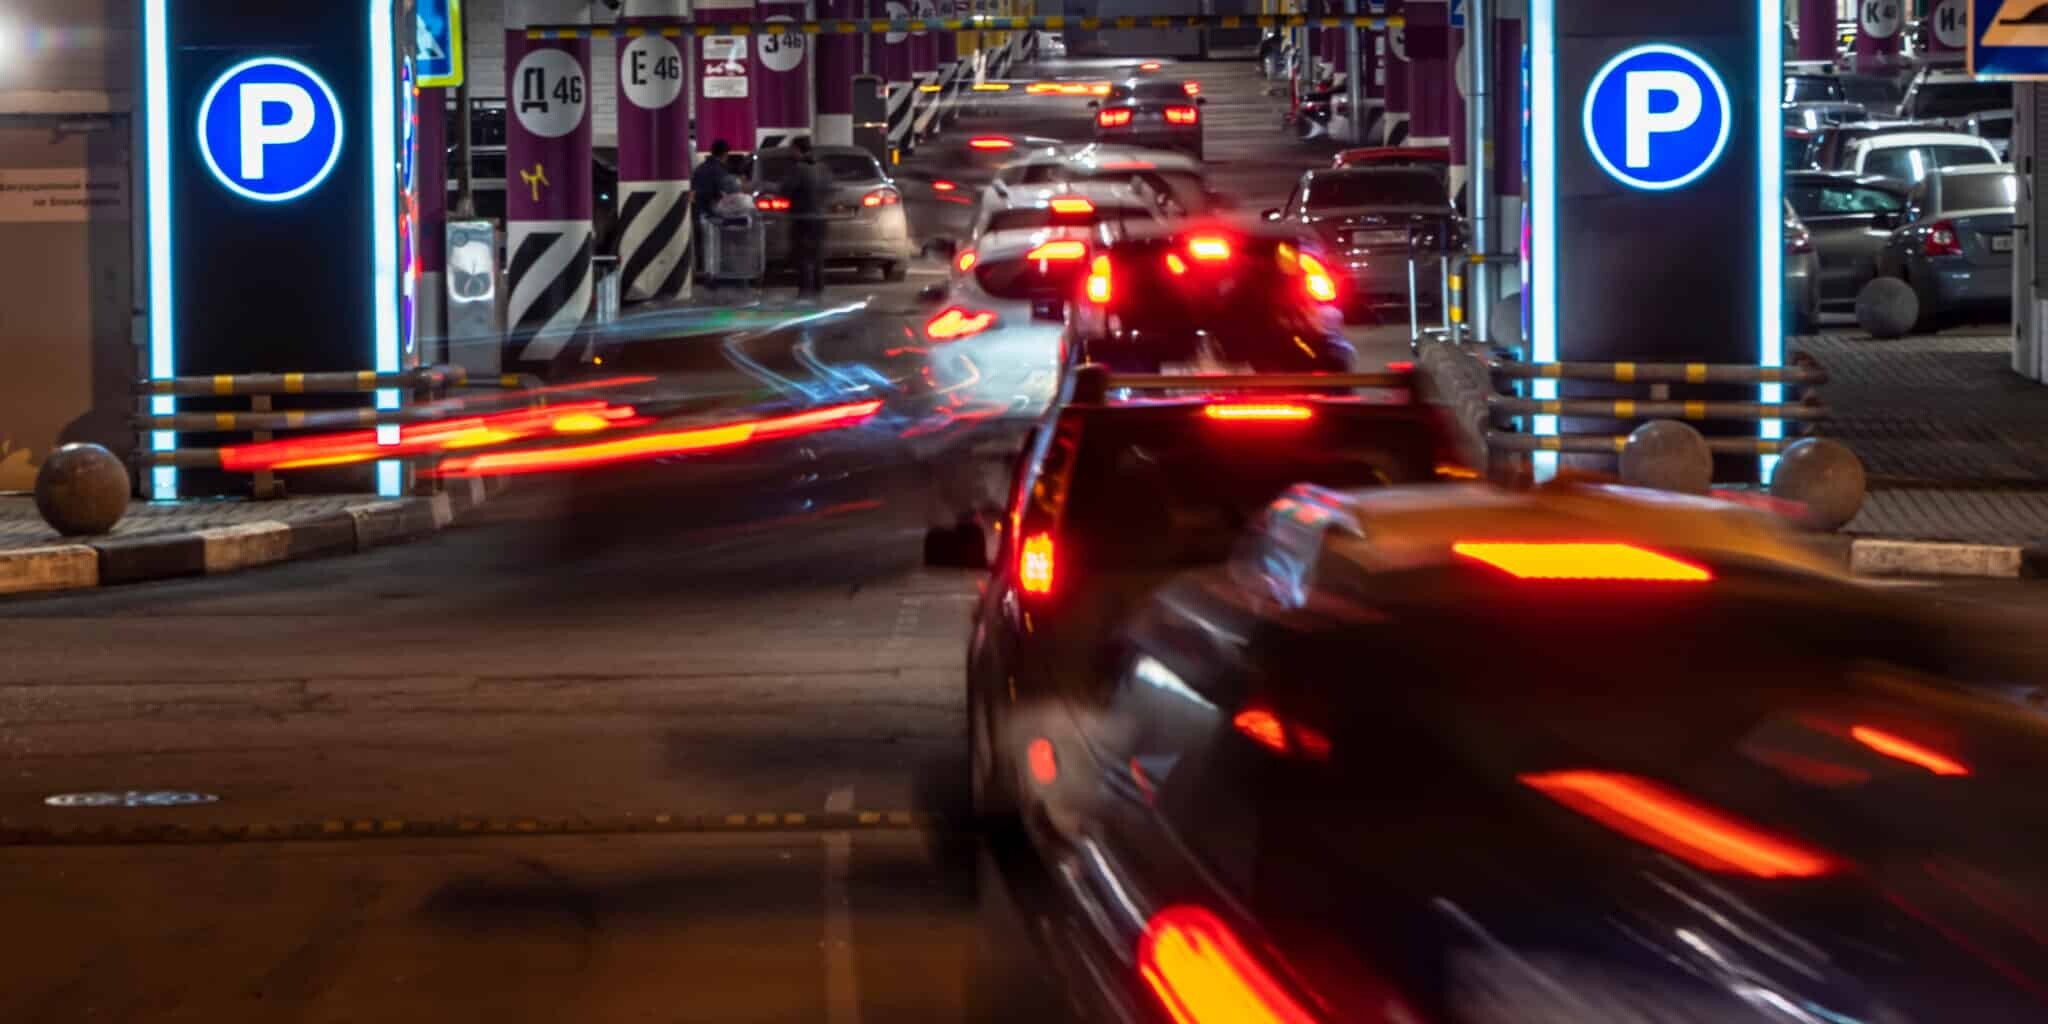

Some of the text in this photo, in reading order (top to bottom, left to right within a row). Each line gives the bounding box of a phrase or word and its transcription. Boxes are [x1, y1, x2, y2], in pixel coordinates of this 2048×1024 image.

[521, 67, 583, 113] Д 46
[653, 56, 679, 80] 46
[240, 83, 315, 179] P
[1626, 70, 1702, 168] P
